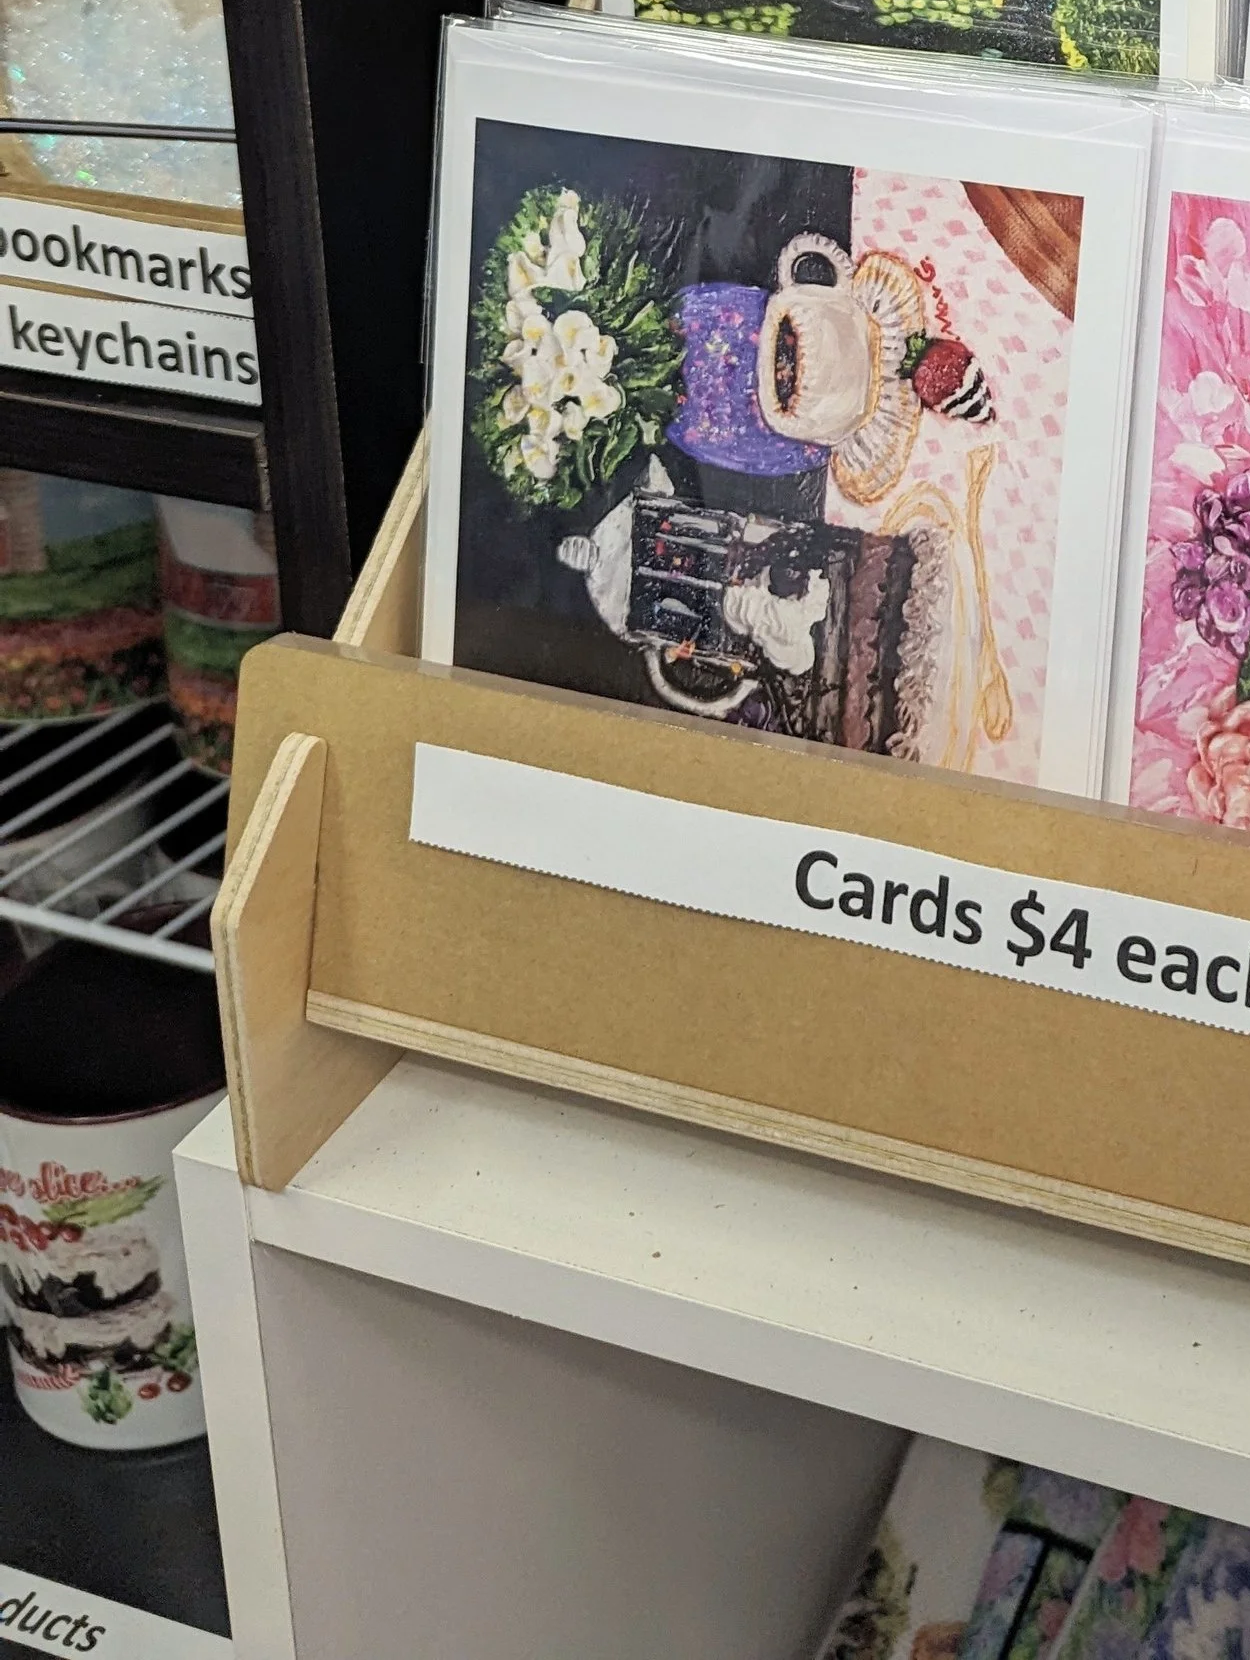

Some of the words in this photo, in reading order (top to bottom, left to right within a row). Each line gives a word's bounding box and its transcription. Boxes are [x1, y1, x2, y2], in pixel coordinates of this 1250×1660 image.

[8, 304, 259, 386] keychains
[795, 849, 984, 945] Cards
[1005, 889, 1093, 967] $4
[0, 1591, 106, 1653] ducts
